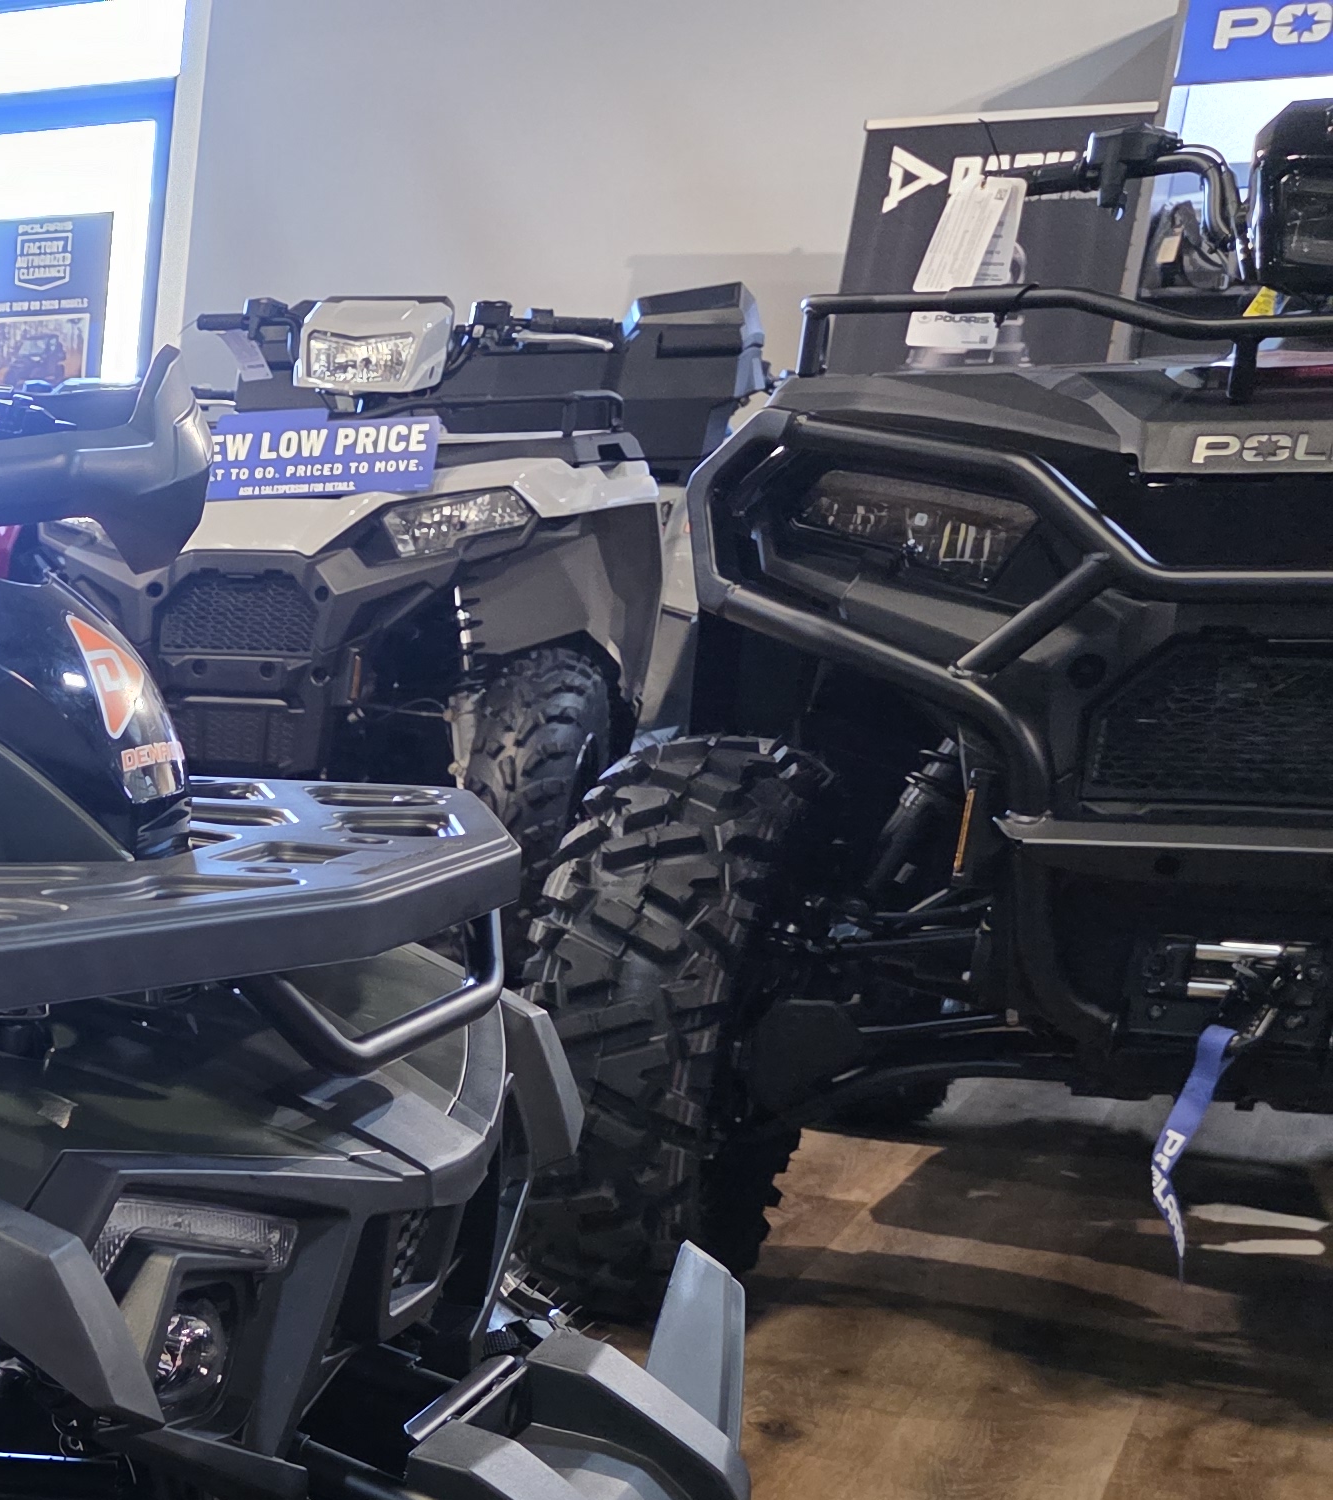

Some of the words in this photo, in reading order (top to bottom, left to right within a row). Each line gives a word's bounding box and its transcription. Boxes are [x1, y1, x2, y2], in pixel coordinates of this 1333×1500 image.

[18, 221, 74, 234] POLARIS
[23, 240, 65, 255] FACTORY
[15, 252, 72, 268] AUTHORIZED
[18, 266, 68, 280] CLEARANCE
[934, 313, 991, 325] POLARIS
[212, 432, 254, 463] EW
[259, 428, 329, 461] LOW
[334, 422, 431, 457] PRICE
[1191, 432, 1333, 464] POL
[230, 467, 249, 481] TO
[254, 466, 281, 480] GO.
[285, 462, 344, 478] PRICED
[348, 461, 369, 475] TO
[374, 459, 424, 473] MOVE.
[238, 486, 254, 496] ASK
